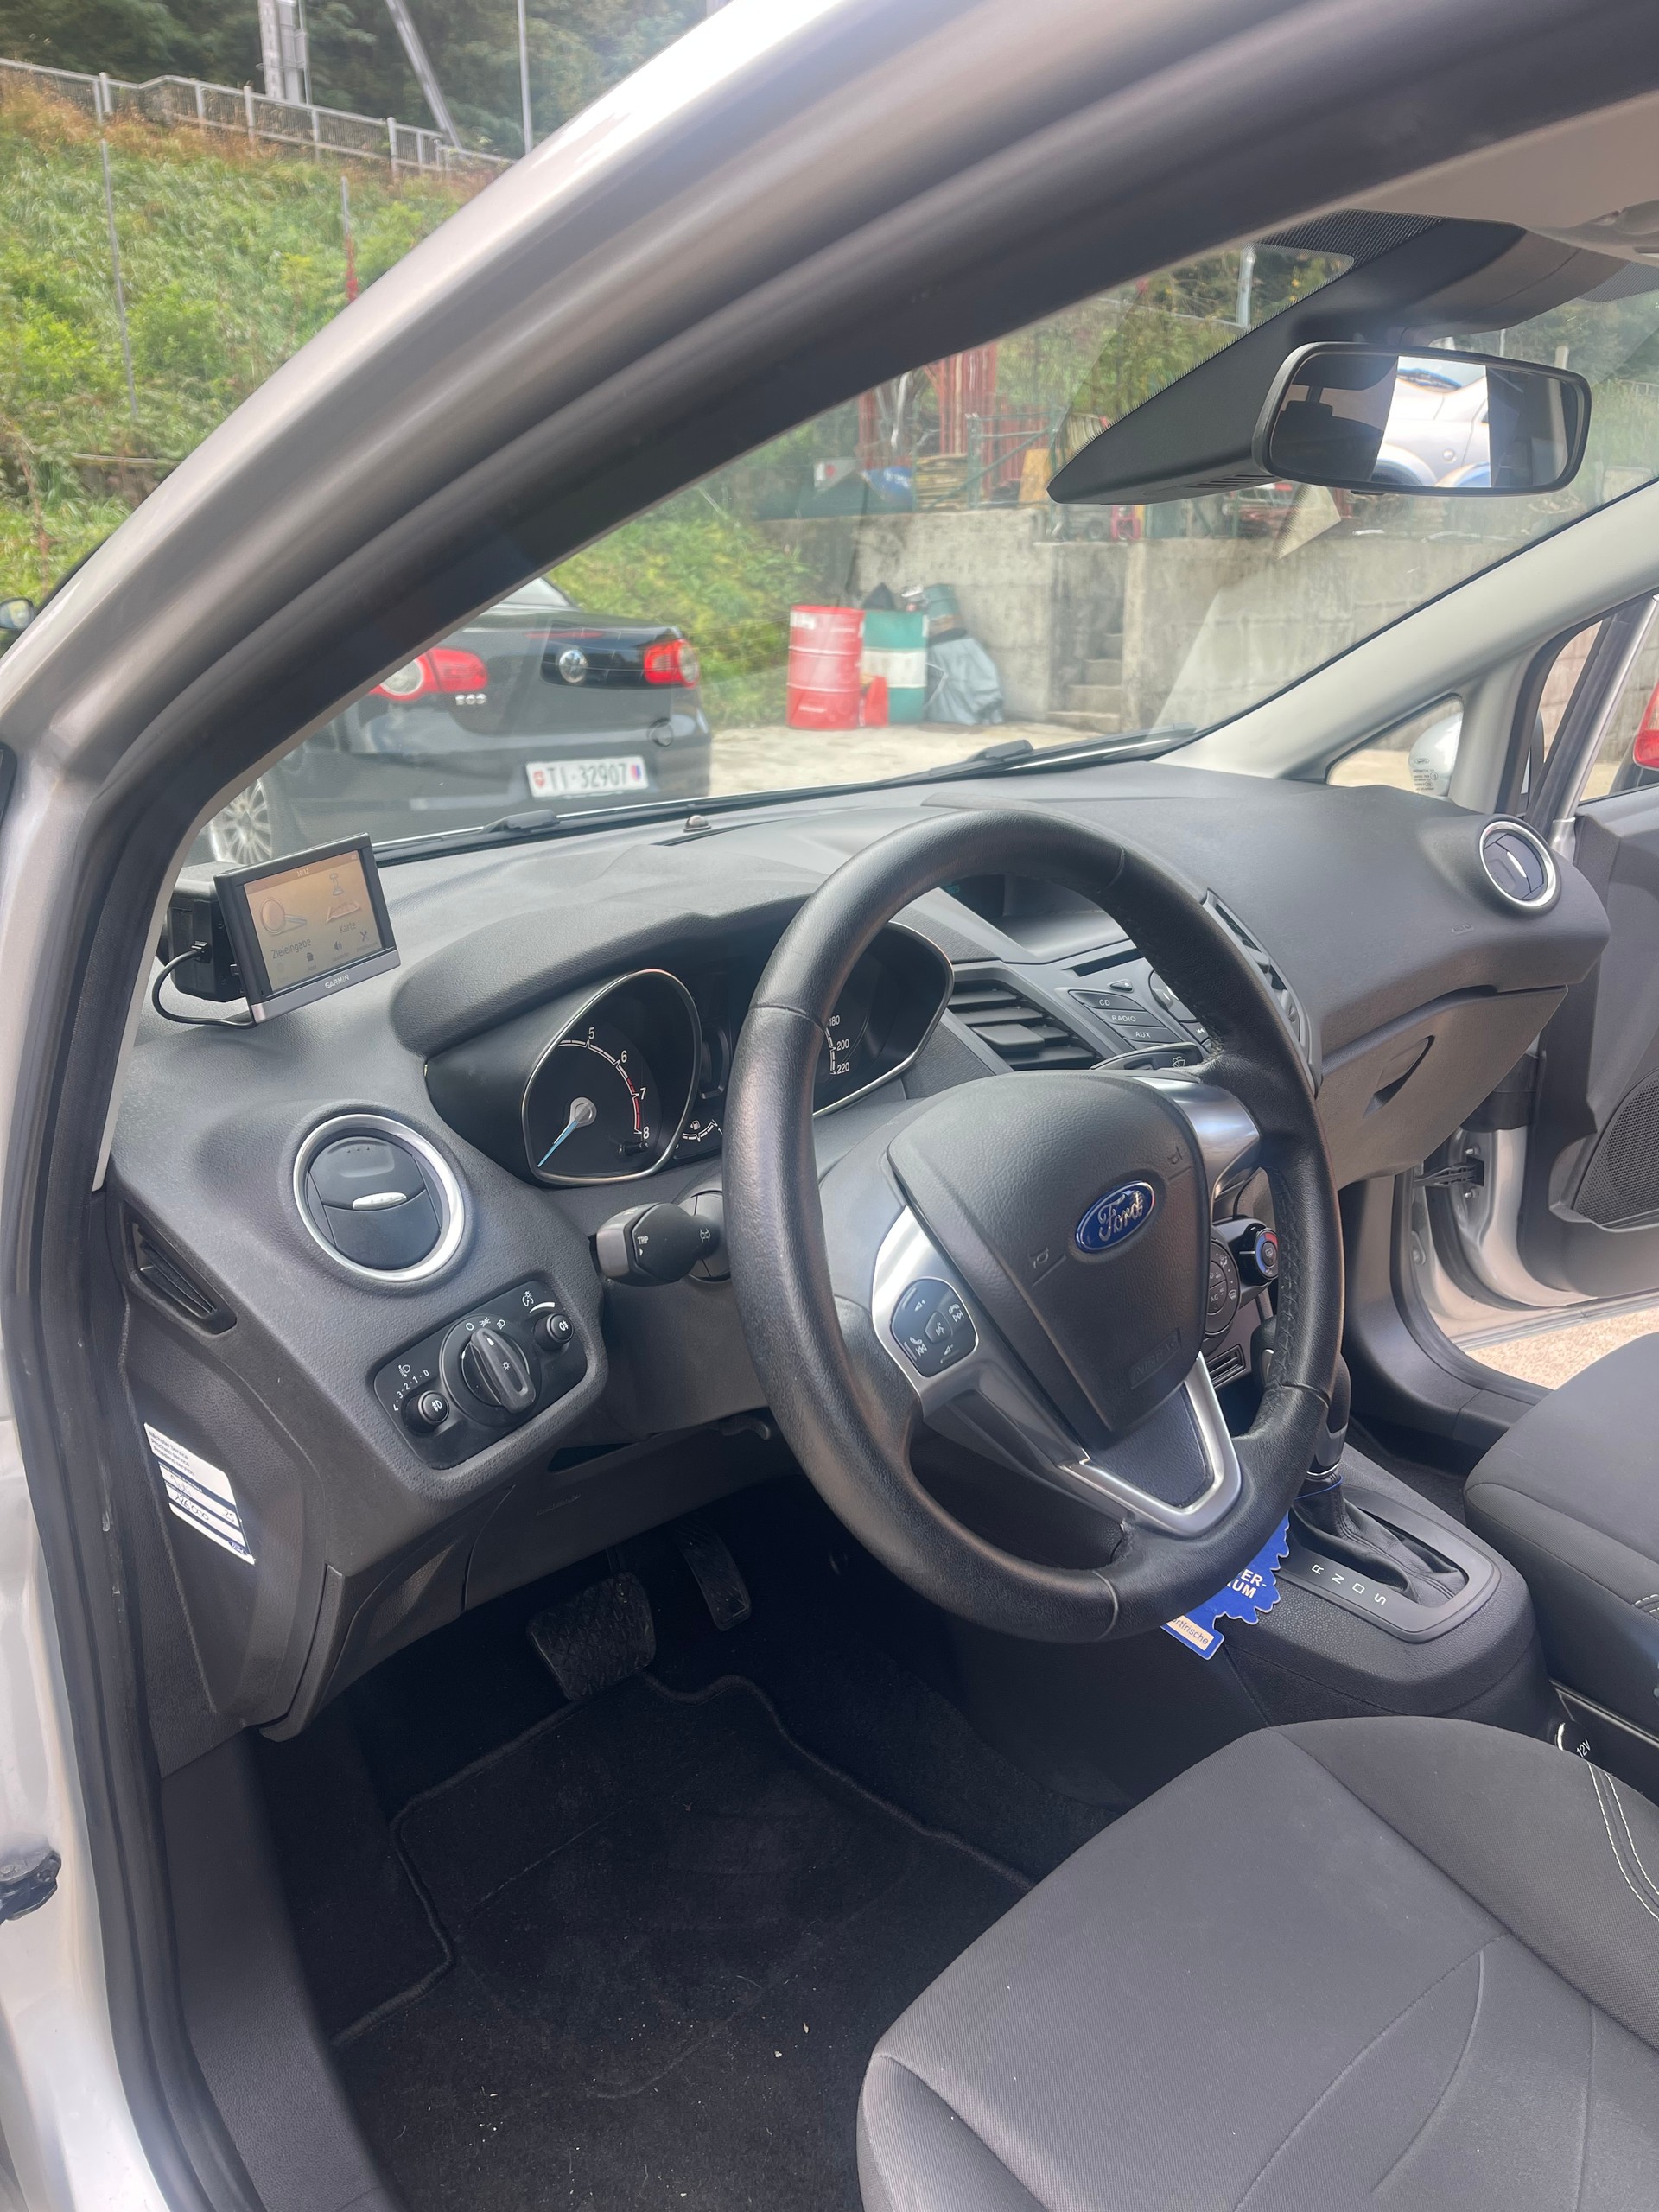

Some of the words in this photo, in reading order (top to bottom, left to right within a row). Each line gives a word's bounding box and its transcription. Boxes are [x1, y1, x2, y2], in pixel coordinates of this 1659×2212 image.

[339, 922, 357, 934] Karte
[271, 938, 312, 959] Zieleingabe
[324, 974, 350, 989] GARMIN
[1098, 998, 1111, 1007] CD
[1111, 1014, 1137, 1023] RADIO
[588, 1027, 595, 1039] 5
[836, 1039, 849, 1052] 200
[620, 1050, 628, 1064] 6
[836, 1061, 850, 1075] 220
[639, 1086, 647, 1101] 7
[642, 1126, 650, 1140] 8
[637, 1235, 649, 1245] TRIP
[1211, 1294, 1219, 1303] AC
[1311, 1564, 1325, 1575] R
[1237, 1568, 1267, 1587] ER-
[1331, 1573, 1344, 1585] N
[1351, 1582, 1365, 1594] D
[1374, 1592, 1387, 1605] S
[1576, 1738, 1591, 1758] 12V
